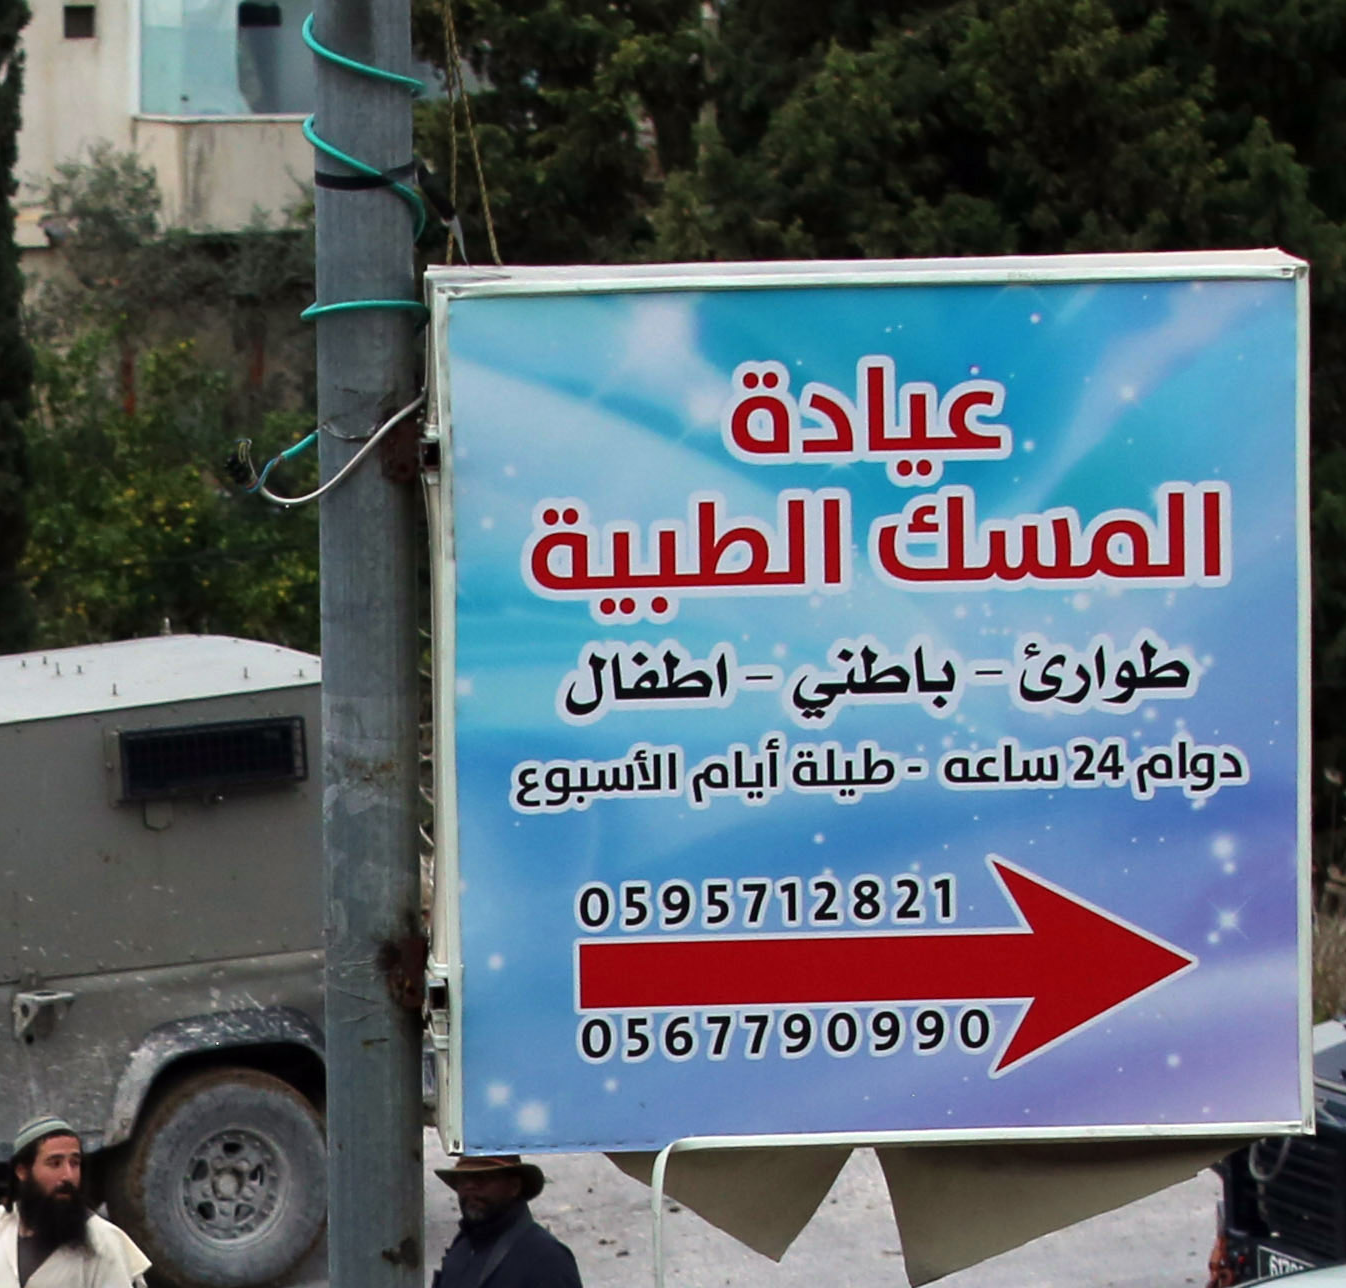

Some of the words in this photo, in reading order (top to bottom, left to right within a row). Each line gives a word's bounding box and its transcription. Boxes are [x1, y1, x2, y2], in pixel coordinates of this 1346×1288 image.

[732, 366, 1002, 477] عيادة
[532, 499, 841, 616] الطبية
[878, 493, 1221, 583] المسك
[792, 645, 956, 720] باطني
[1019, 640, 1190, 705] طوارئ
[516, 749, 677, 807] الأسبوع
[692, 738, 780, 803] أيام
[792, 747, 895, 789] طيلة
[1073, 744, 1124, 781] 24
[1137, 741, 1242, 793] دوام
[579, 879, 953, 927] 0595712821
[582, 1009, 991, 1060] 0567790990
